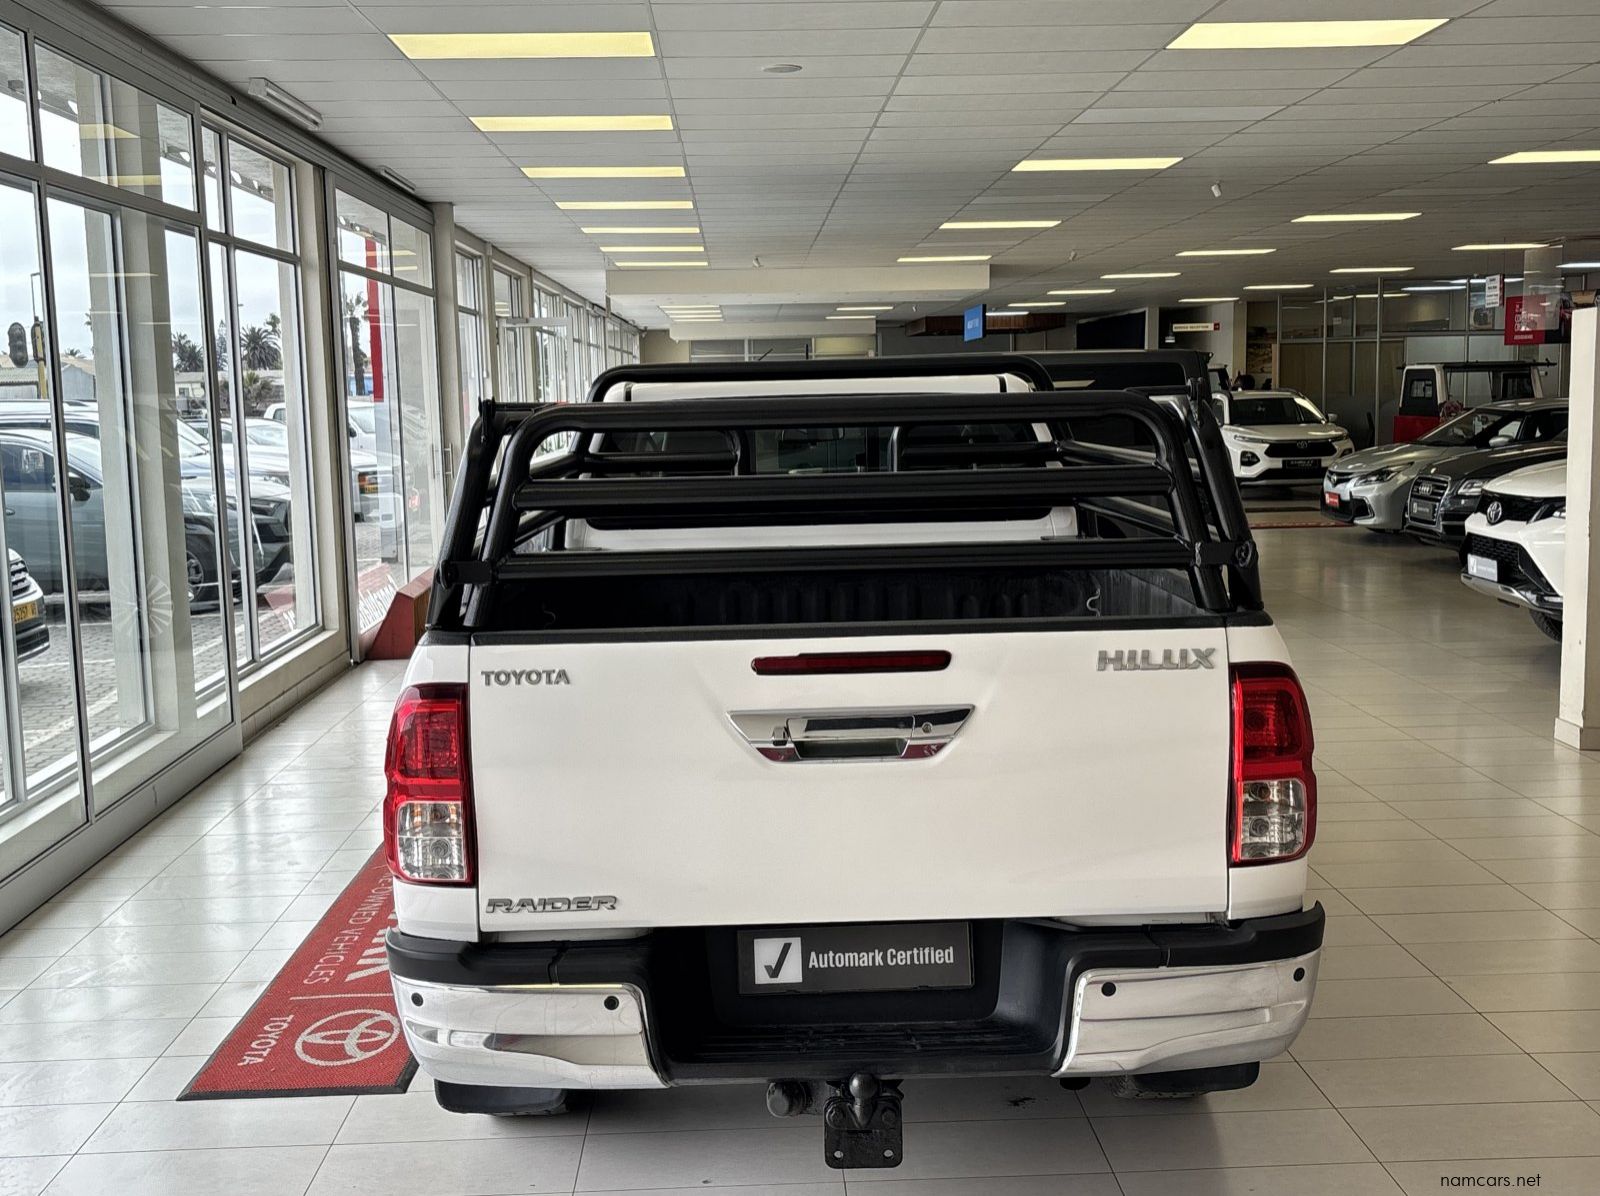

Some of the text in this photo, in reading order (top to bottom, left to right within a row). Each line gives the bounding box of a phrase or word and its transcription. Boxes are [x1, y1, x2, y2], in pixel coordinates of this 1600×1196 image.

[1096, 648, 1216, 672] HILUX
[480, 668, 571, 686] TOYOTA
[485, 895, 618, 915] RAIDER
[303, 927, 366, 985] VEHICLES
[808, 946, 954, 969] Automark Certified
[236, 1014, 295, 1067] TOYOTA
